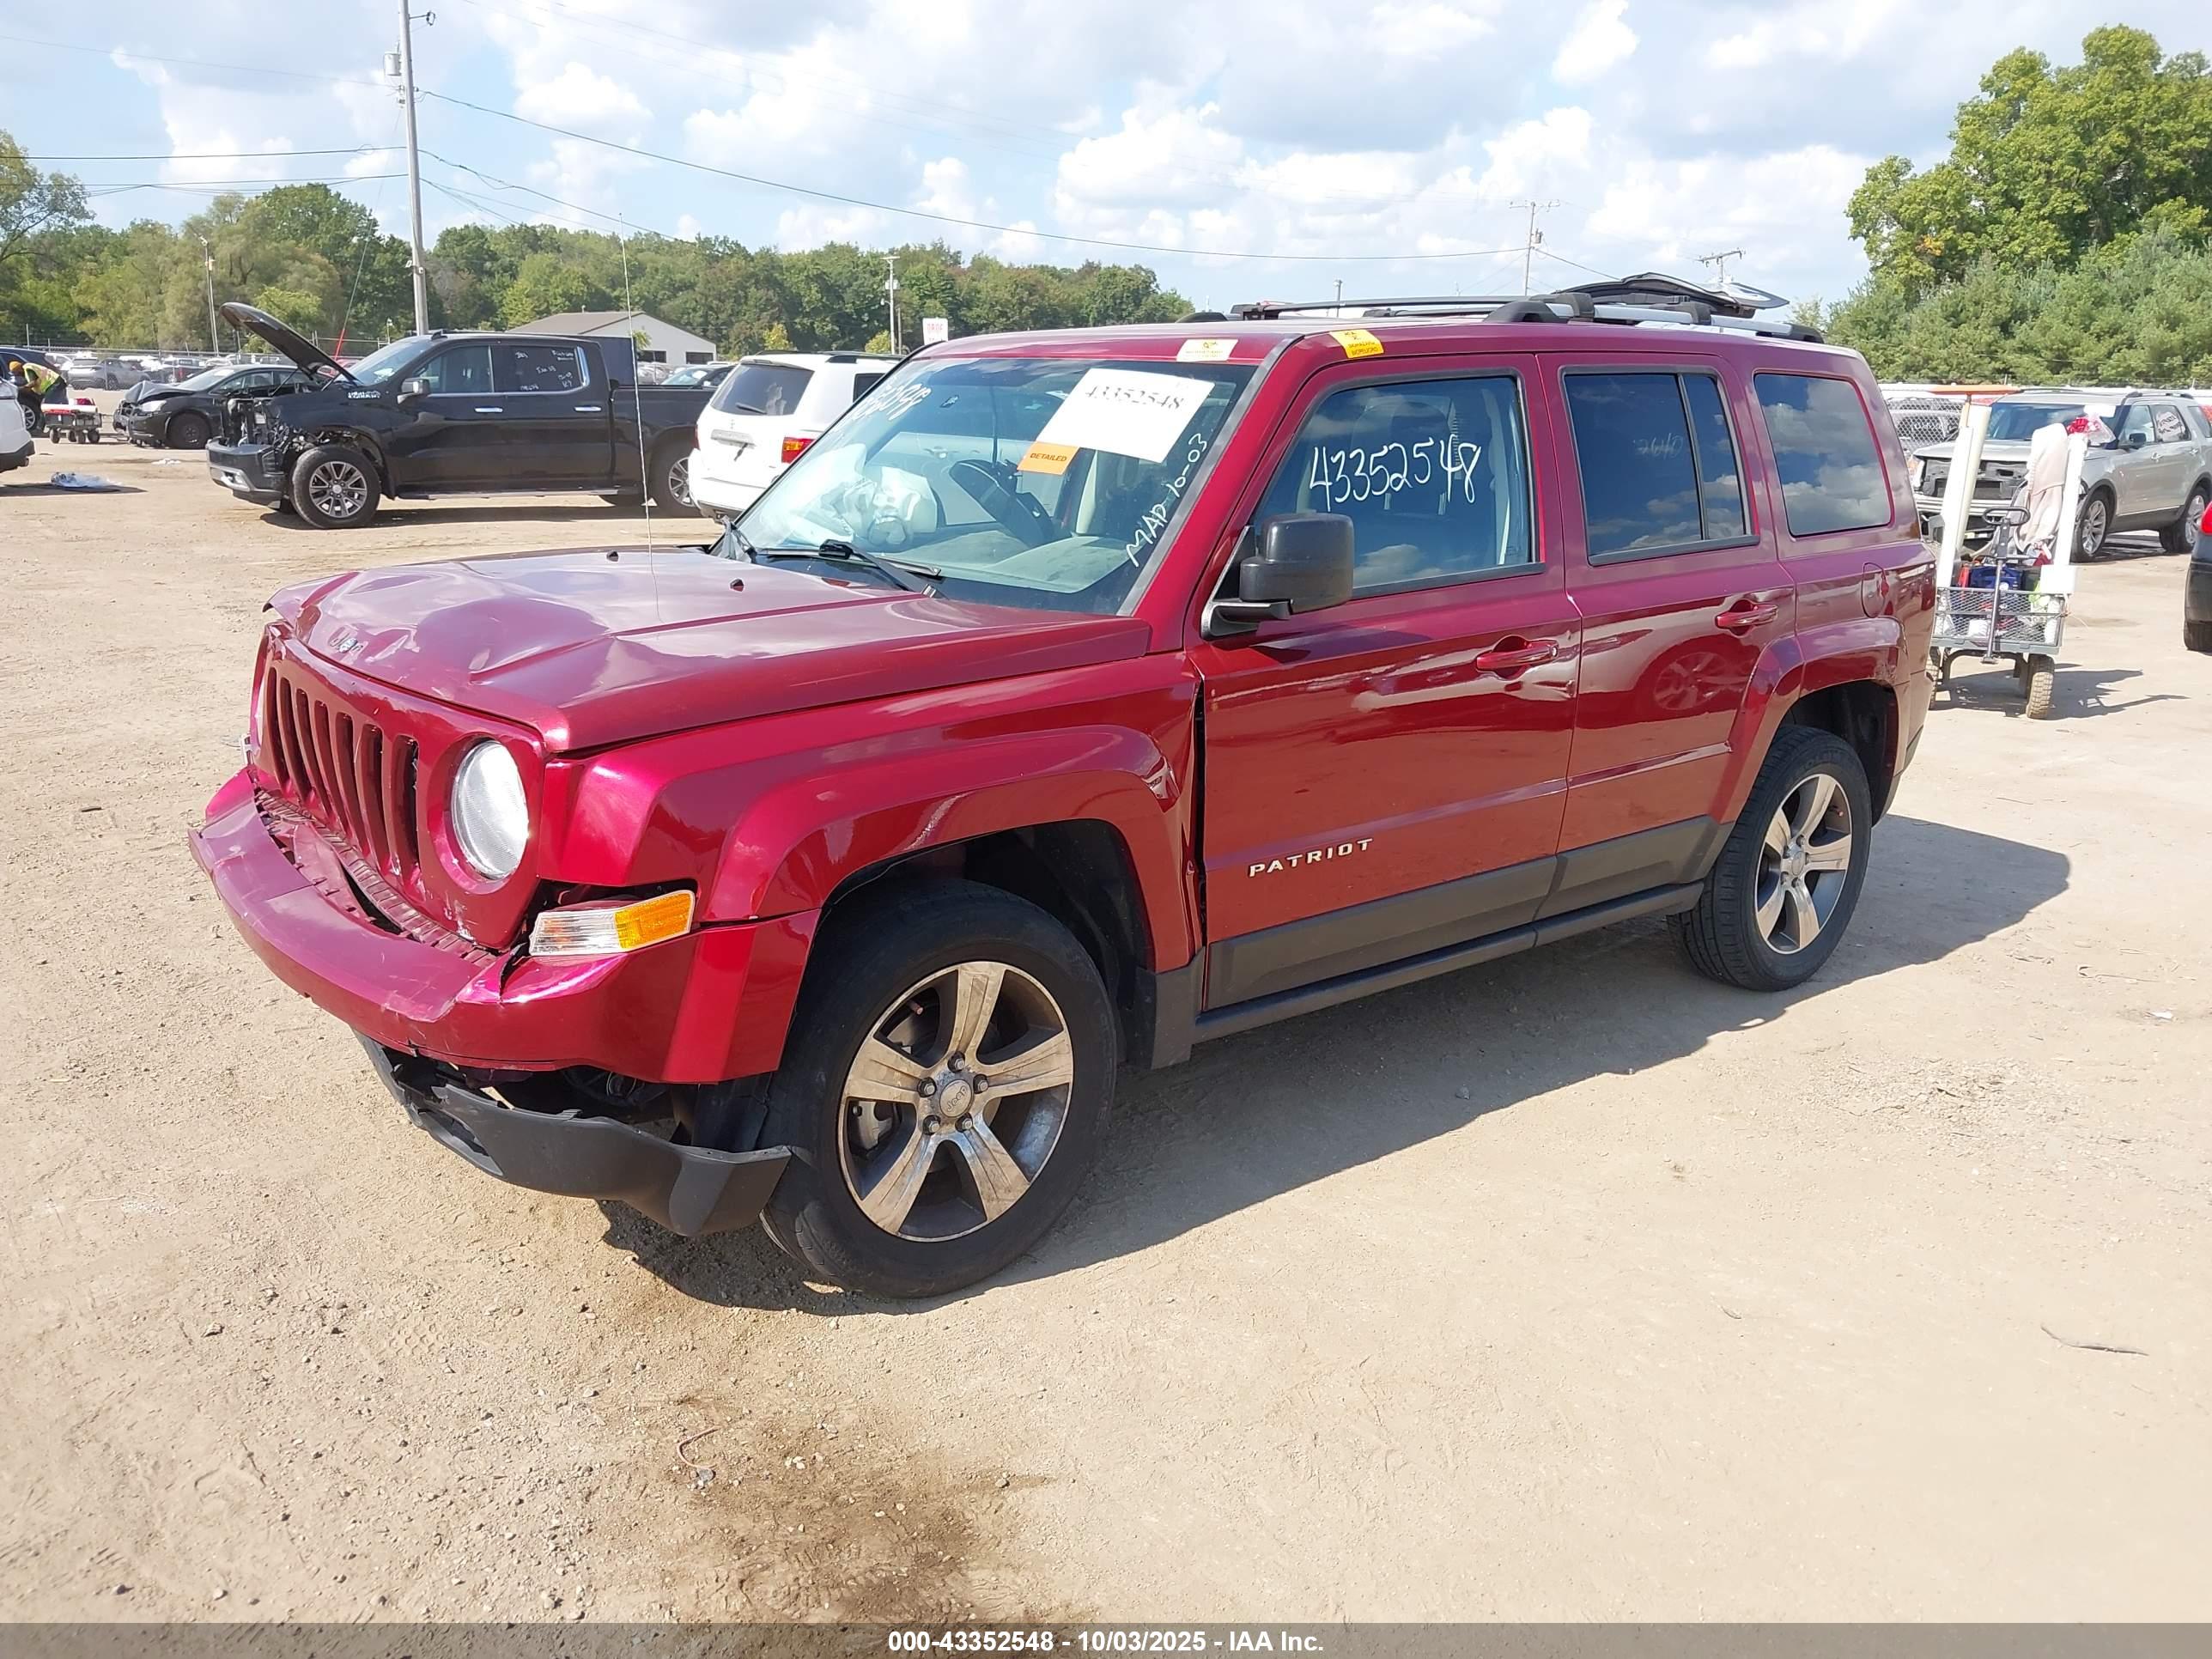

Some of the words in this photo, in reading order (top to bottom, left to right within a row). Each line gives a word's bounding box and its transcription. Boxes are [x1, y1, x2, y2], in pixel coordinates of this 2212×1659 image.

[1030, 452, 1068, 462] DETAILED
[1164, 432, 1208, 498] 10-03
[1309, 433, 1482, 513] 43352548
[1249, 837, 1373, 878] PATRIOT
[946, 1085, 968, 1113] Jeep
